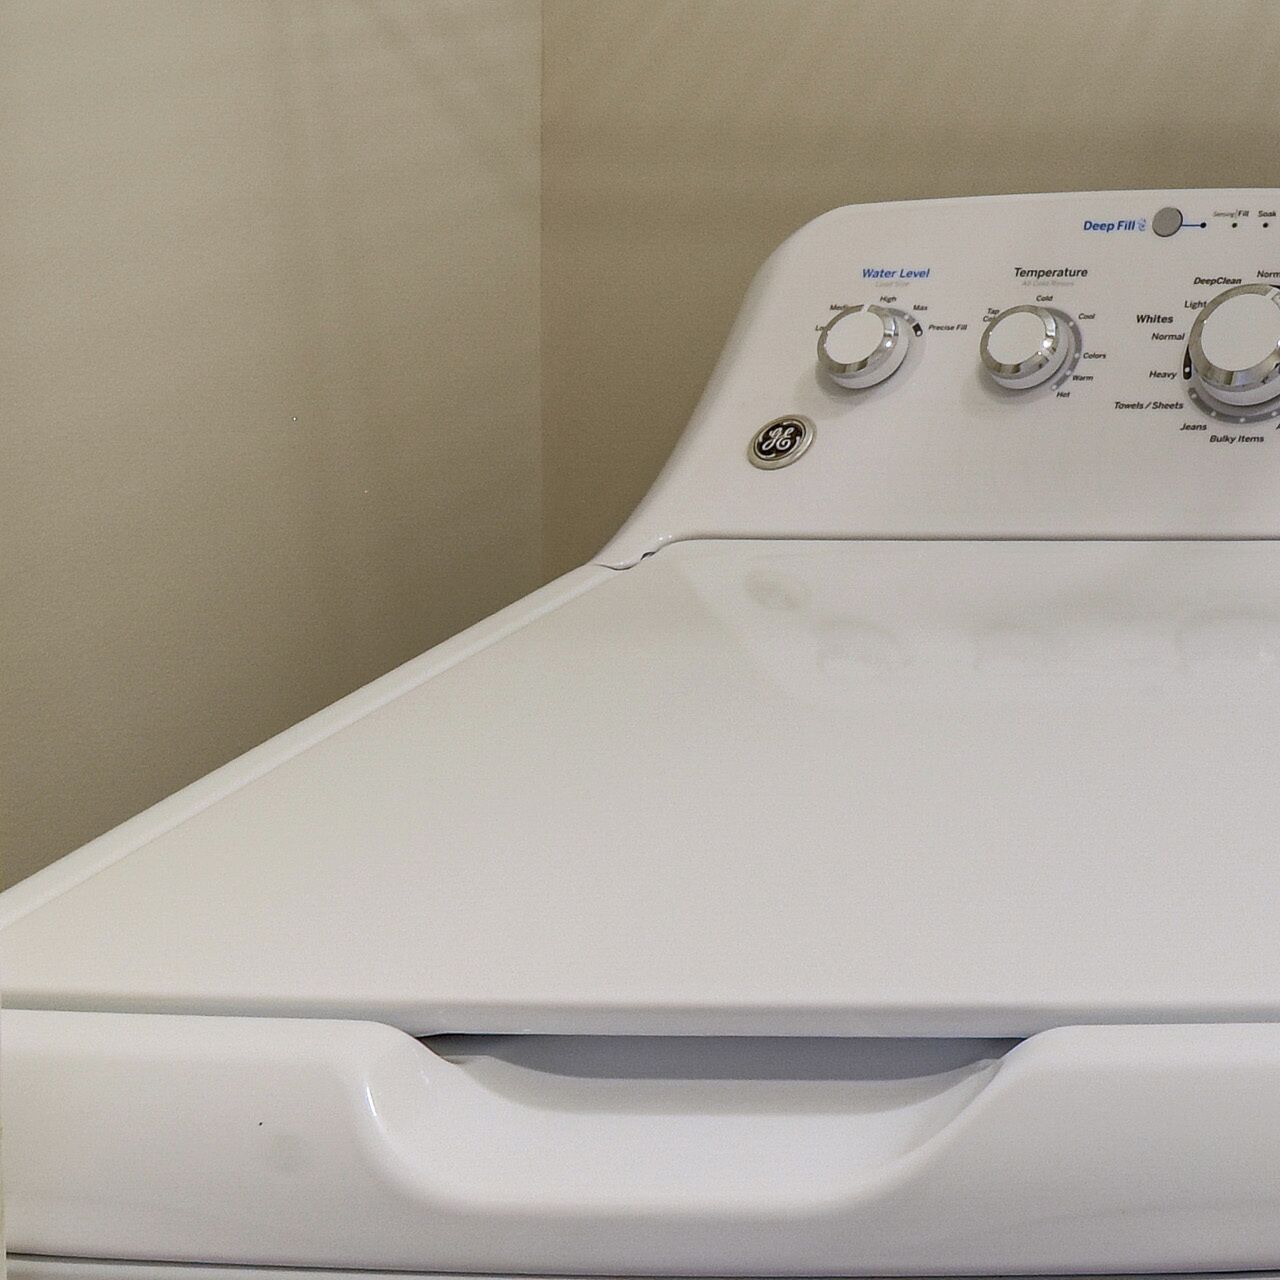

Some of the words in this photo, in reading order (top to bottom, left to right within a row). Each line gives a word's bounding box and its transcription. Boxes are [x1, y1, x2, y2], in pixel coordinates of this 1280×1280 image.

[1083, 220, 1115, 232] Deep
[1117, 220, 1135, 230] Fill
[862, 269, 895, 278] Water
[900, 268, 930, 278] Level
[1014, 267, 1088, 279] Temperature
[1193, 277, 1242, 286] DeepClean
[1184, 300, 1207, 309] Light
[1136, 314, 1173, 324] Whites
[1151, 333, 1185, 341] Normal
[1149, 371, 1177, 379] Heavy
[1114, 401, 1144, 409] Towels
[1151, 401, 1184, 409] Sheets
[1180, 423, 1207, 431] Jeans
[1209, 435, 1236, 444] Bulky
[1238, 435, 1264, 443] Items
